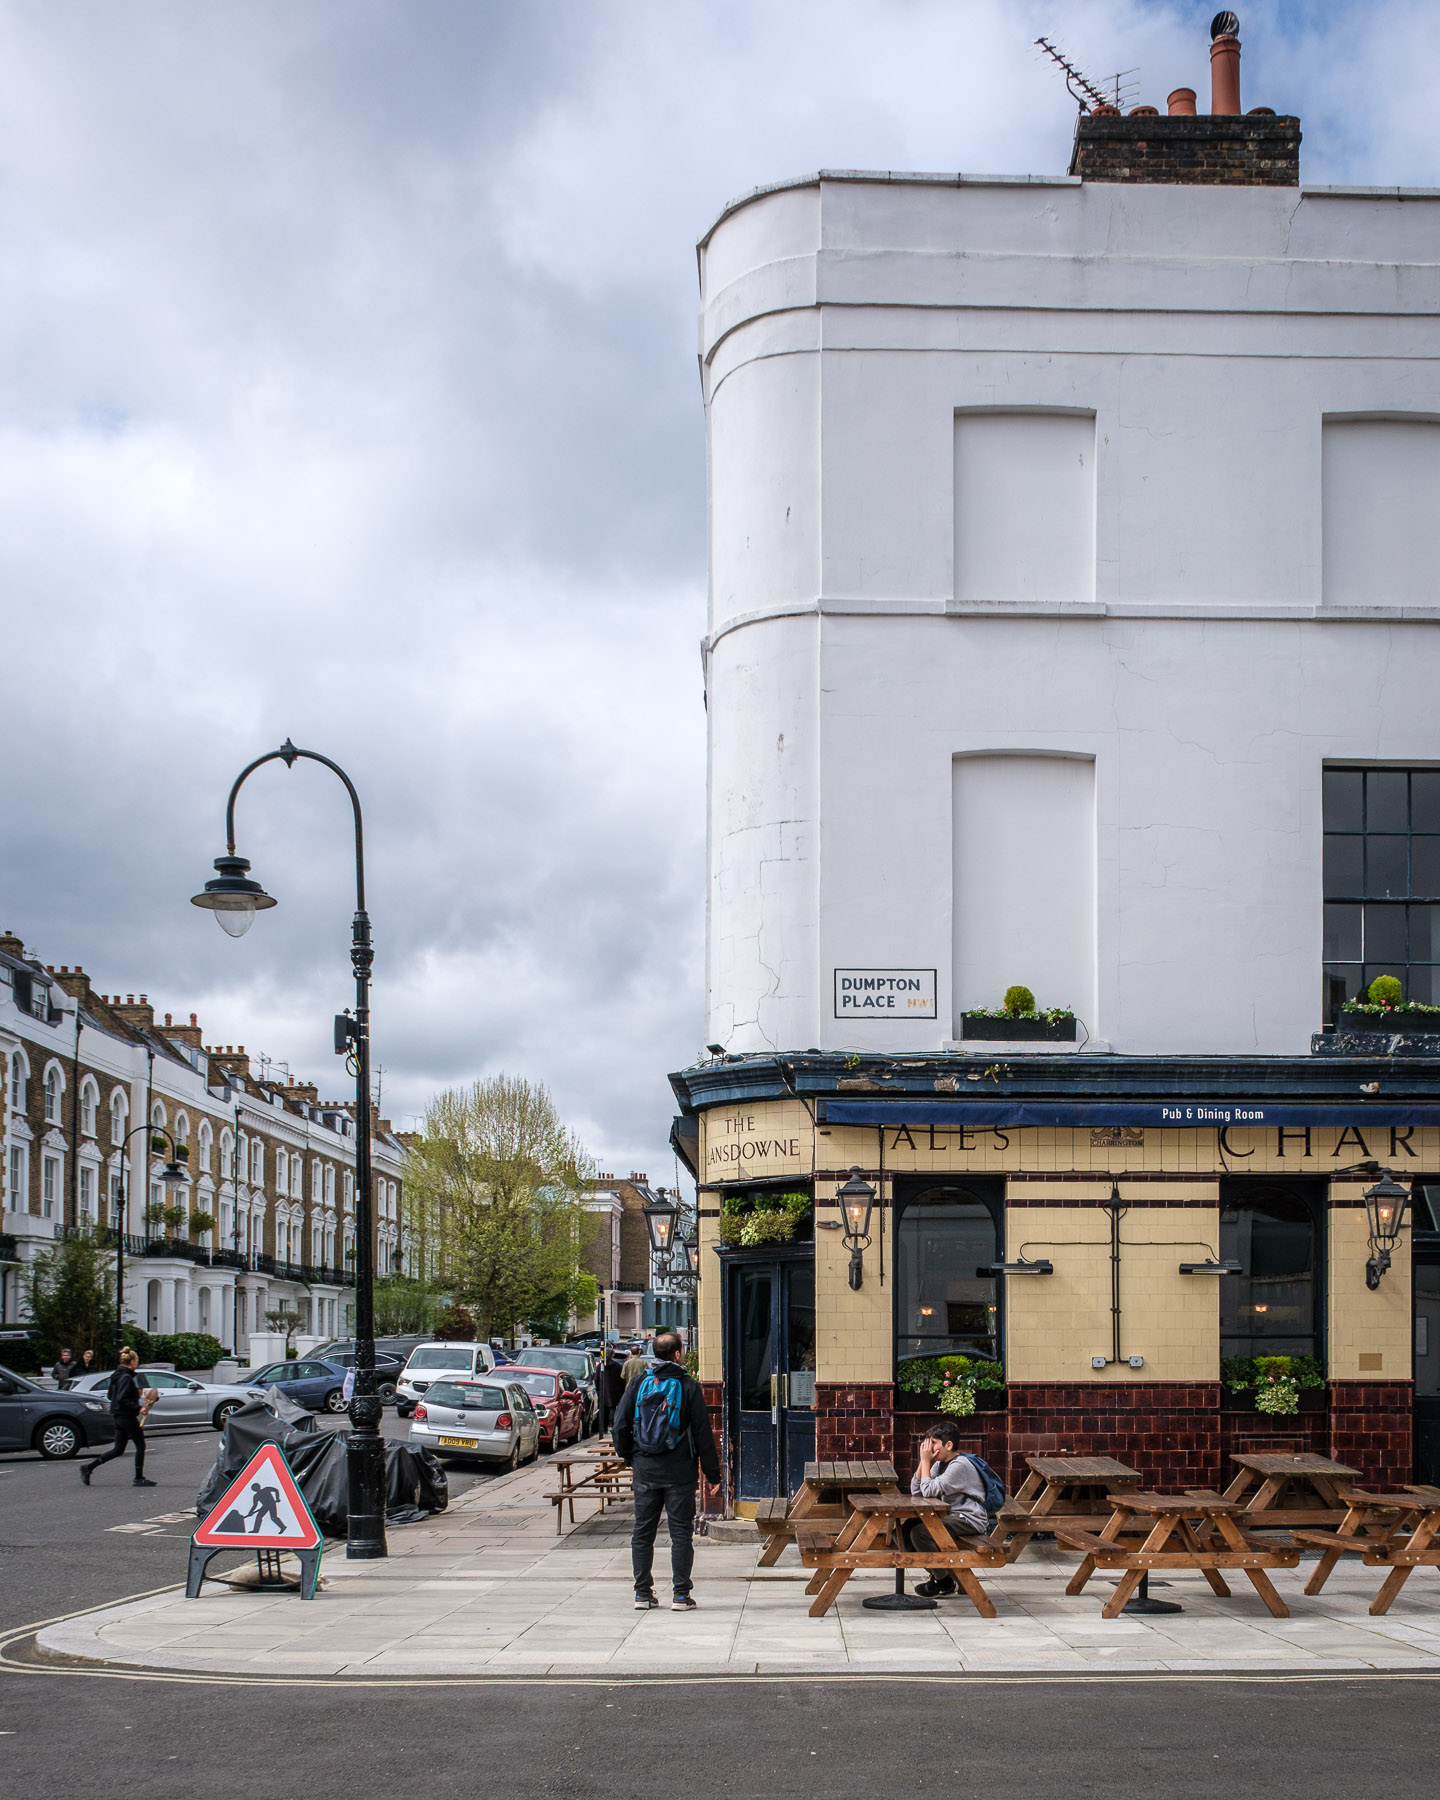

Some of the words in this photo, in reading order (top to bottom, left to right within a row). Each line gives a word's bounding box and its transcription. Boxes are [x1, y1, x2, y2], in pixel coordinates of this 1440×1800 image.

[841, 977, 920, 991] DUMPTON
[842, 995, 895, 1008] PLACE
[1162, 1108, 1182, 1120] Pub
[1186, 1108, 1193, 1119] &
[1197, 1108, 1231, 1122] Dining
[1235, 1108, 1264, 1120] Room
[725, 1116, 755, 1134] THE
[890, 1124, 1010, 1151] ALES
